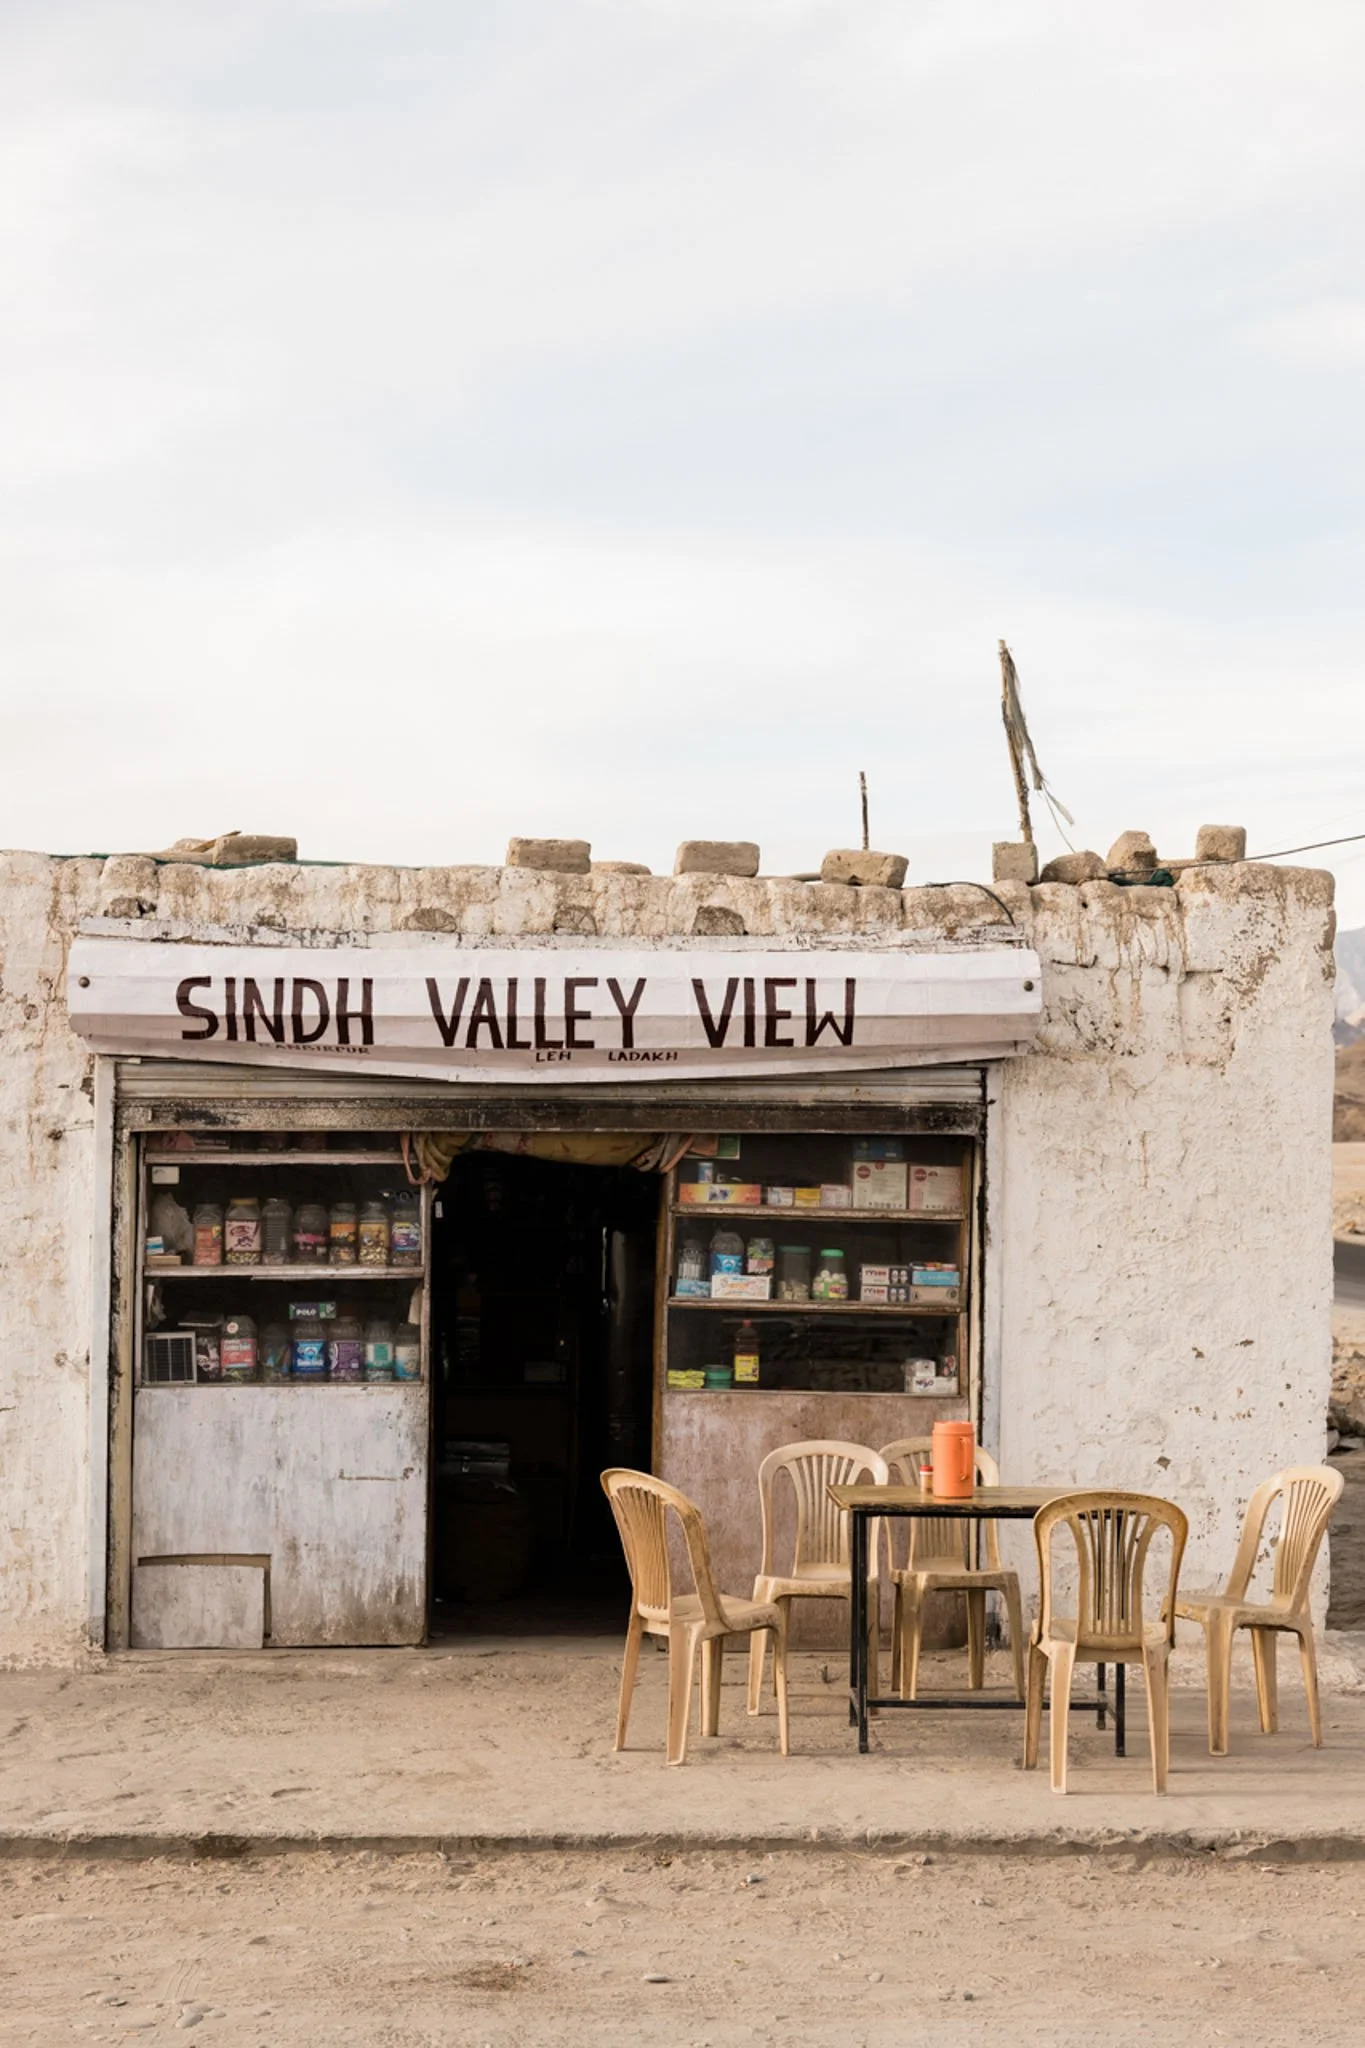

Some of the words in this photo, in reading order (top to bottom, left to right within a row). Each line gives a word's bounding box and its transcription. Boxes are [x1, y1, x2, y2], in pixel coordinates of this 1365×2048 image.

[175, 976, 375, 1046] SINDH
[425, 977, 647, 1050] VALLEY
[691, 977, 856, 1048] VIEW
[535, 1051, 572, 1063] LEH
[607, 1051, 679, 1062] LADAKH
